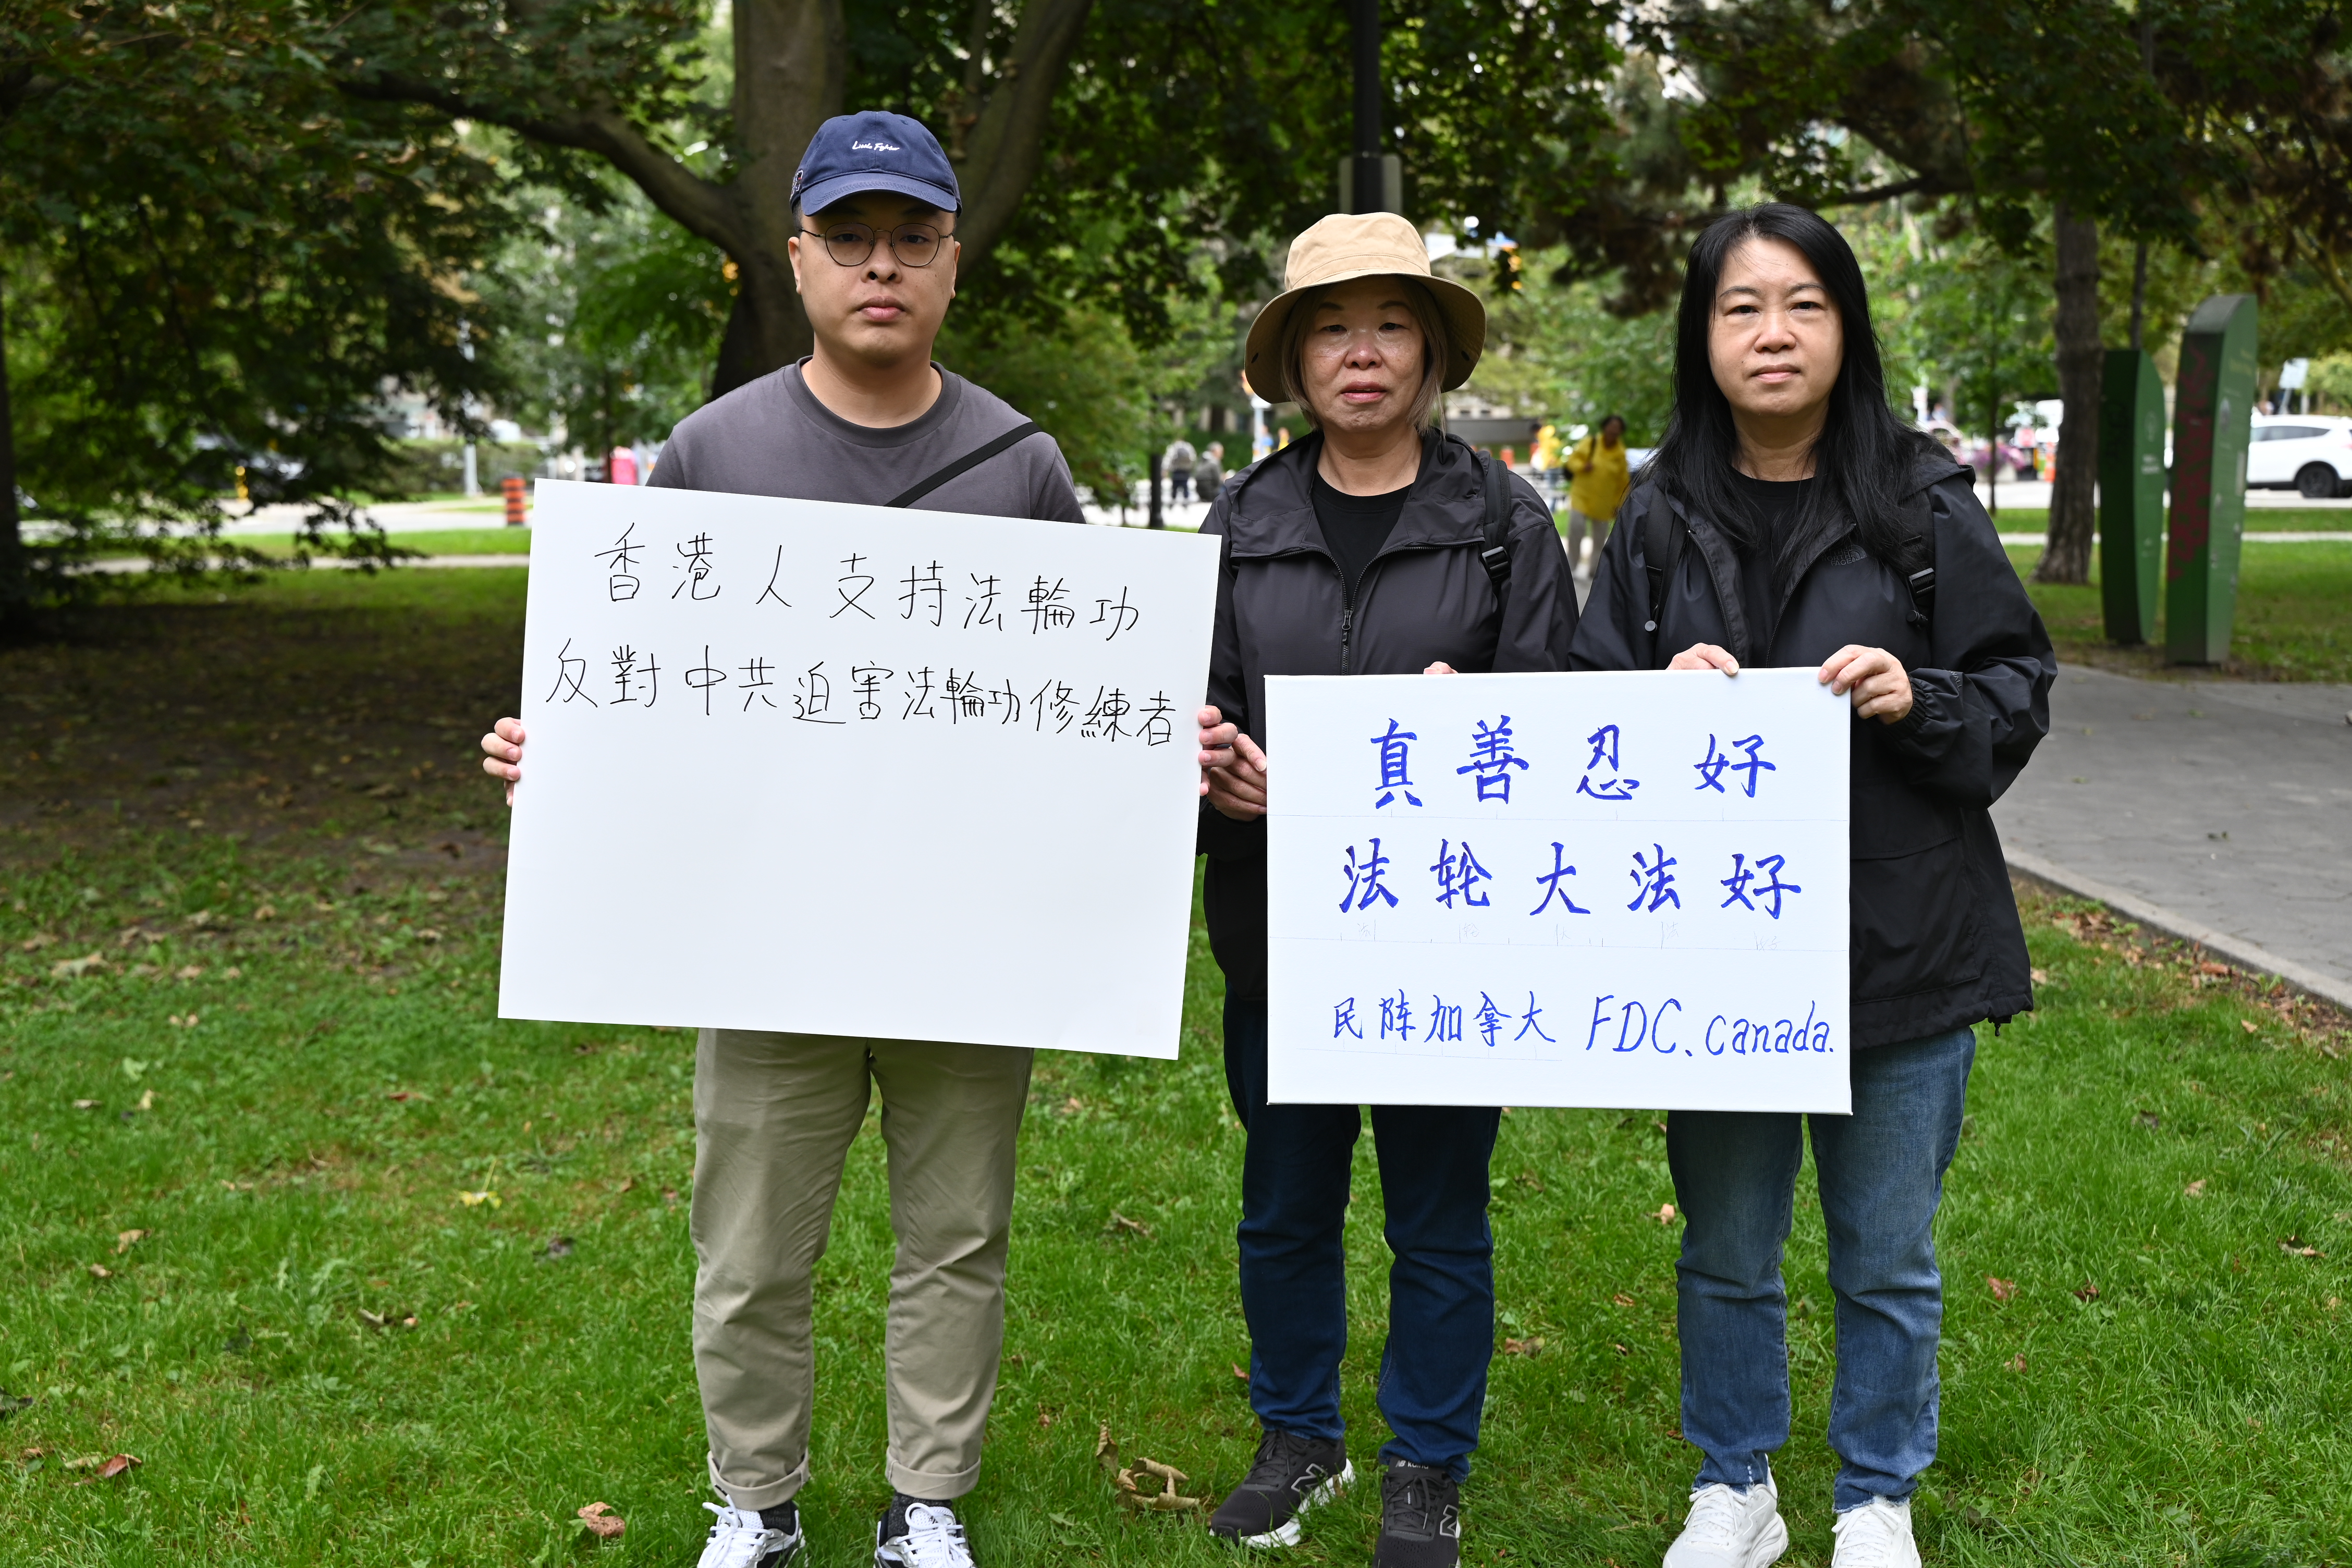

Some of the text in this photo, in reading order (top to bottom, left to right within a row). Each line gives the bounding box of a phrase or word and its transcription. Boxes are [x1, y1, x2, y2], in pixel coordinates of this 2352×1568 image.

[852, 141, 900, 151] Little Fighter
[595, 523, 1138, 641] 香港人支持法輪功
[1830, 558, 1853, 566] FACE
[1370, 715, 1776, 809] 真善忍好
[1340, 838, 1801, 920] 法轮大法好
